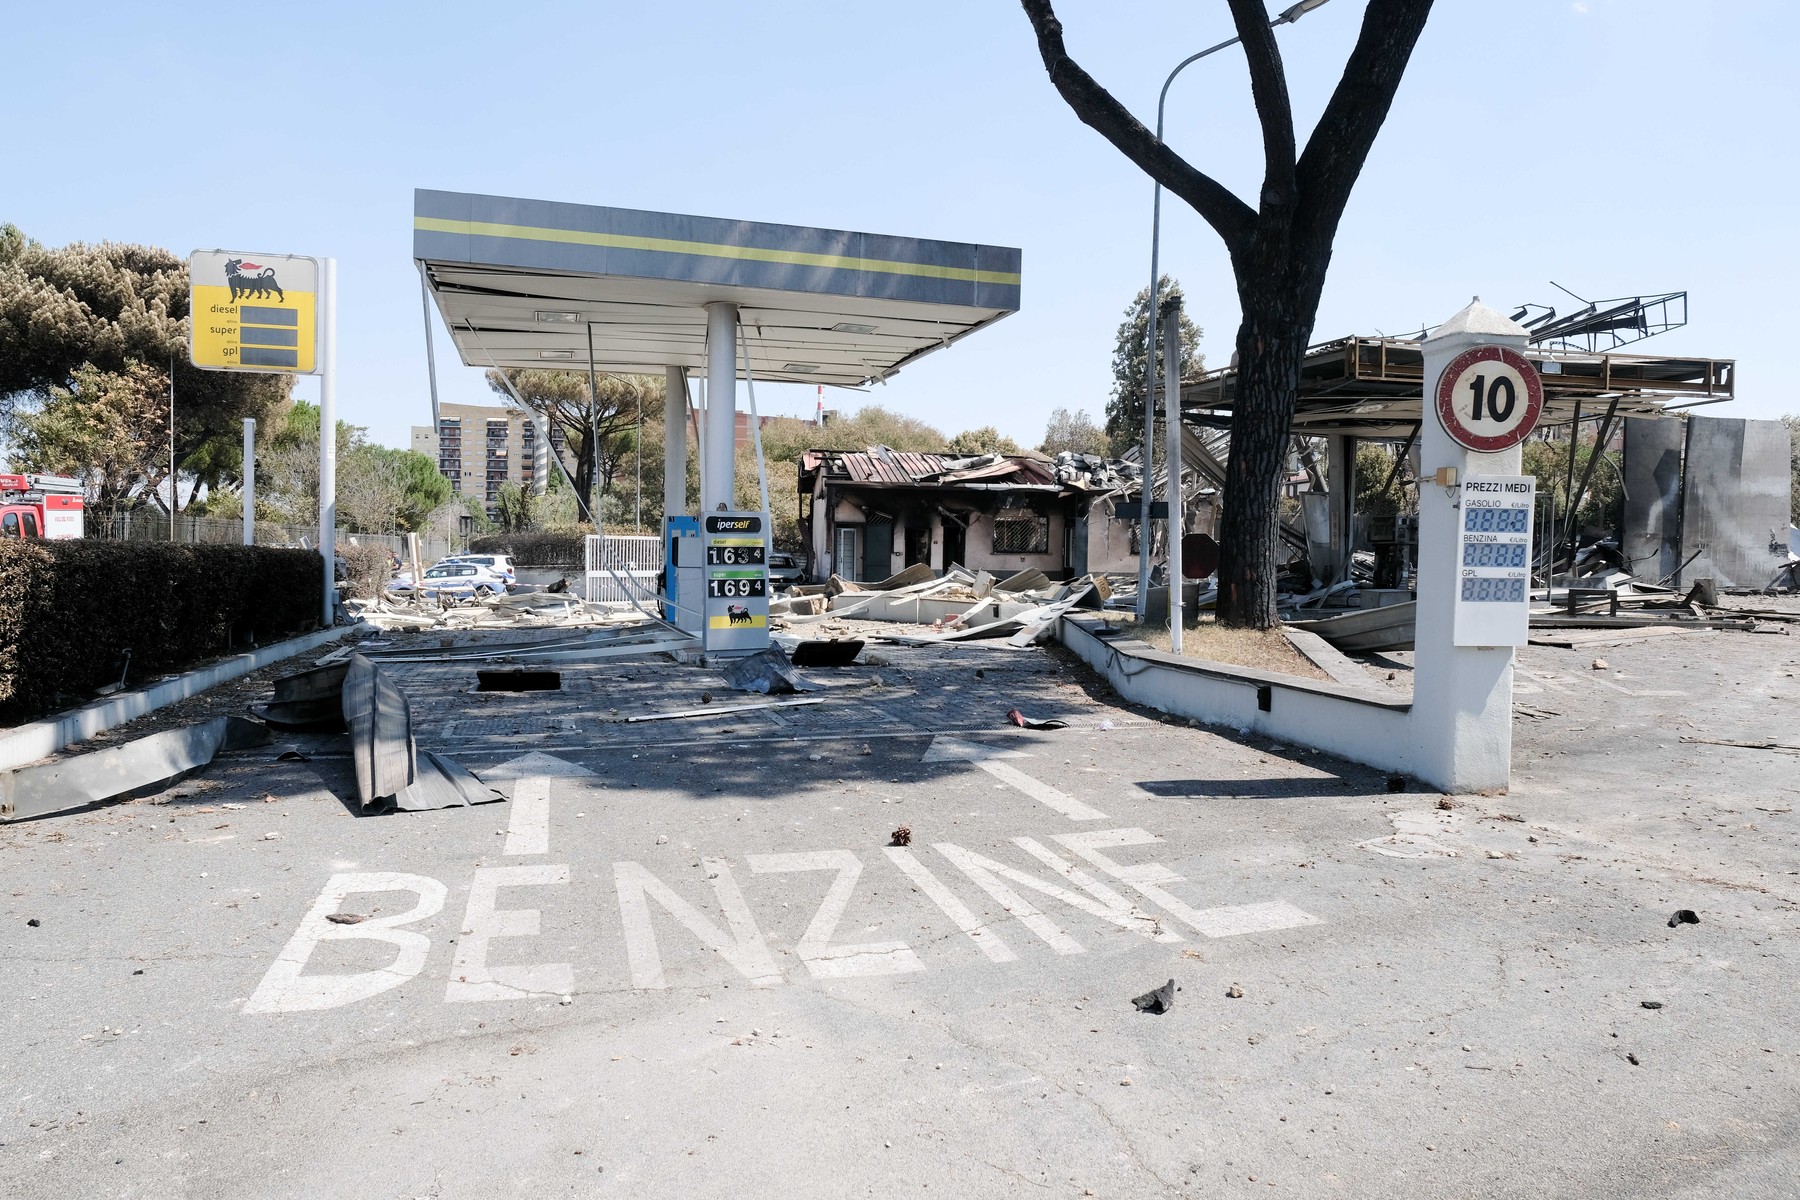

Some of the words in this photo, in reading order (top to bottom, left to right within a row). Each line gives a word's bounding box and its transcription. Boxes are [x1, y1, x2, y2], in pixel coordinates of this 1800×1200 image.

[210, 304, 238, 314] diesel
[210, 326, 237, 336] super
[222, 346, 238, 357] gpl
[1469, 374, 1516, 423] 10
[1465, 482, 1503, 492] PREZZI
[1504, 483, 1531, 493] MEDI
[1465, 499, 1501, 508] GASOLIO
[717, 519, 750, 530] iperself
[1463, 534, 1498, 543] BENZINA
[1462, 569, 1478, 577] GPL
[243, 827, 1326, 1014] BENZINE
